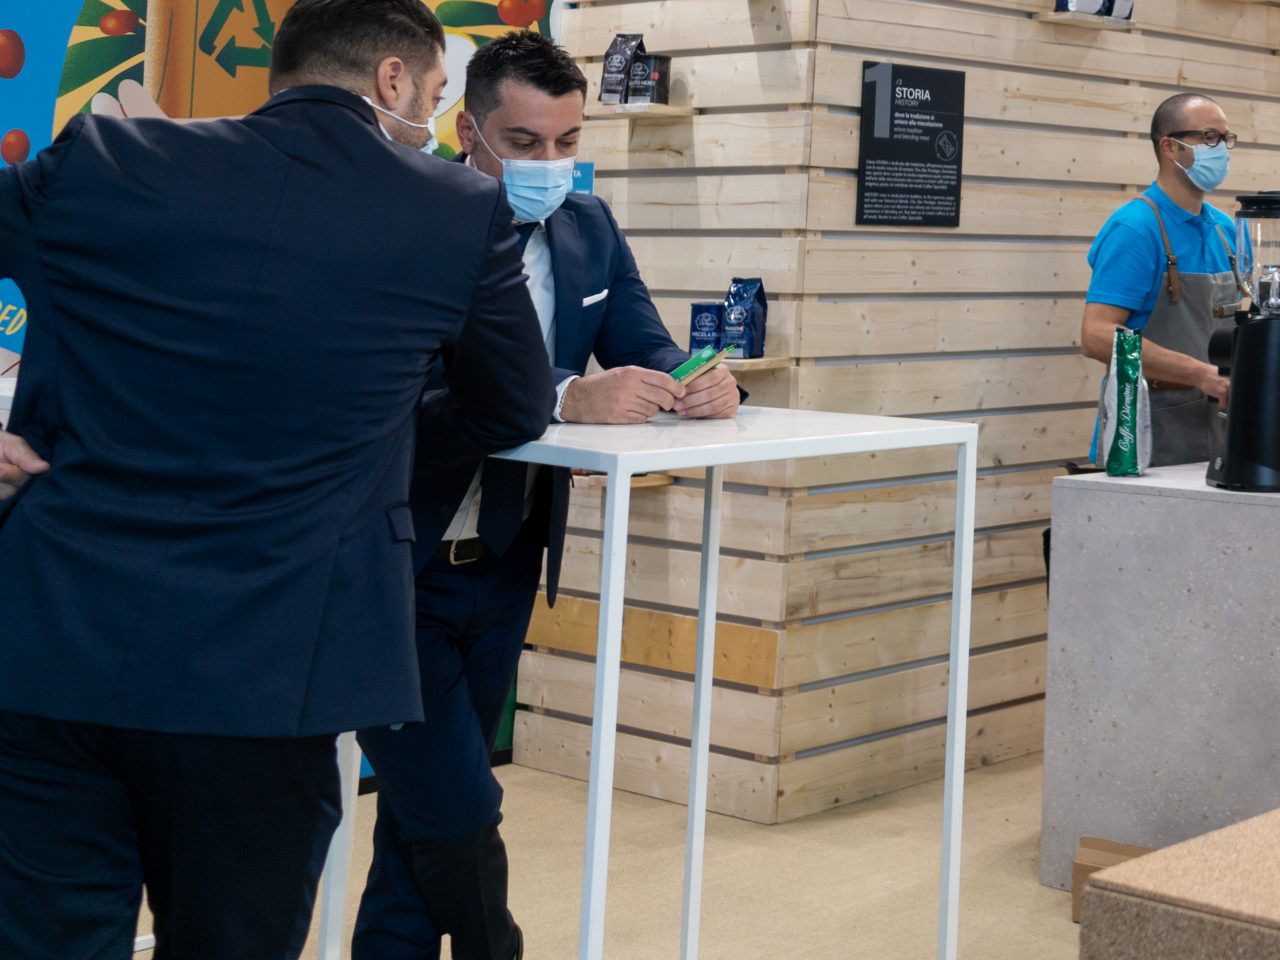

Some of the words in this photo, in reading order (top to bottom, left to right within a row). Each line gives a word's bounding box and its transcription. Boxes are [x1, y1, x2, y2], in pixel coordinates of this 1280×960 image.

[864, 62, 893, 139] 1
[895, 86, 932, 101] STORIA
[894, 98, 920, 107] HISTORY
